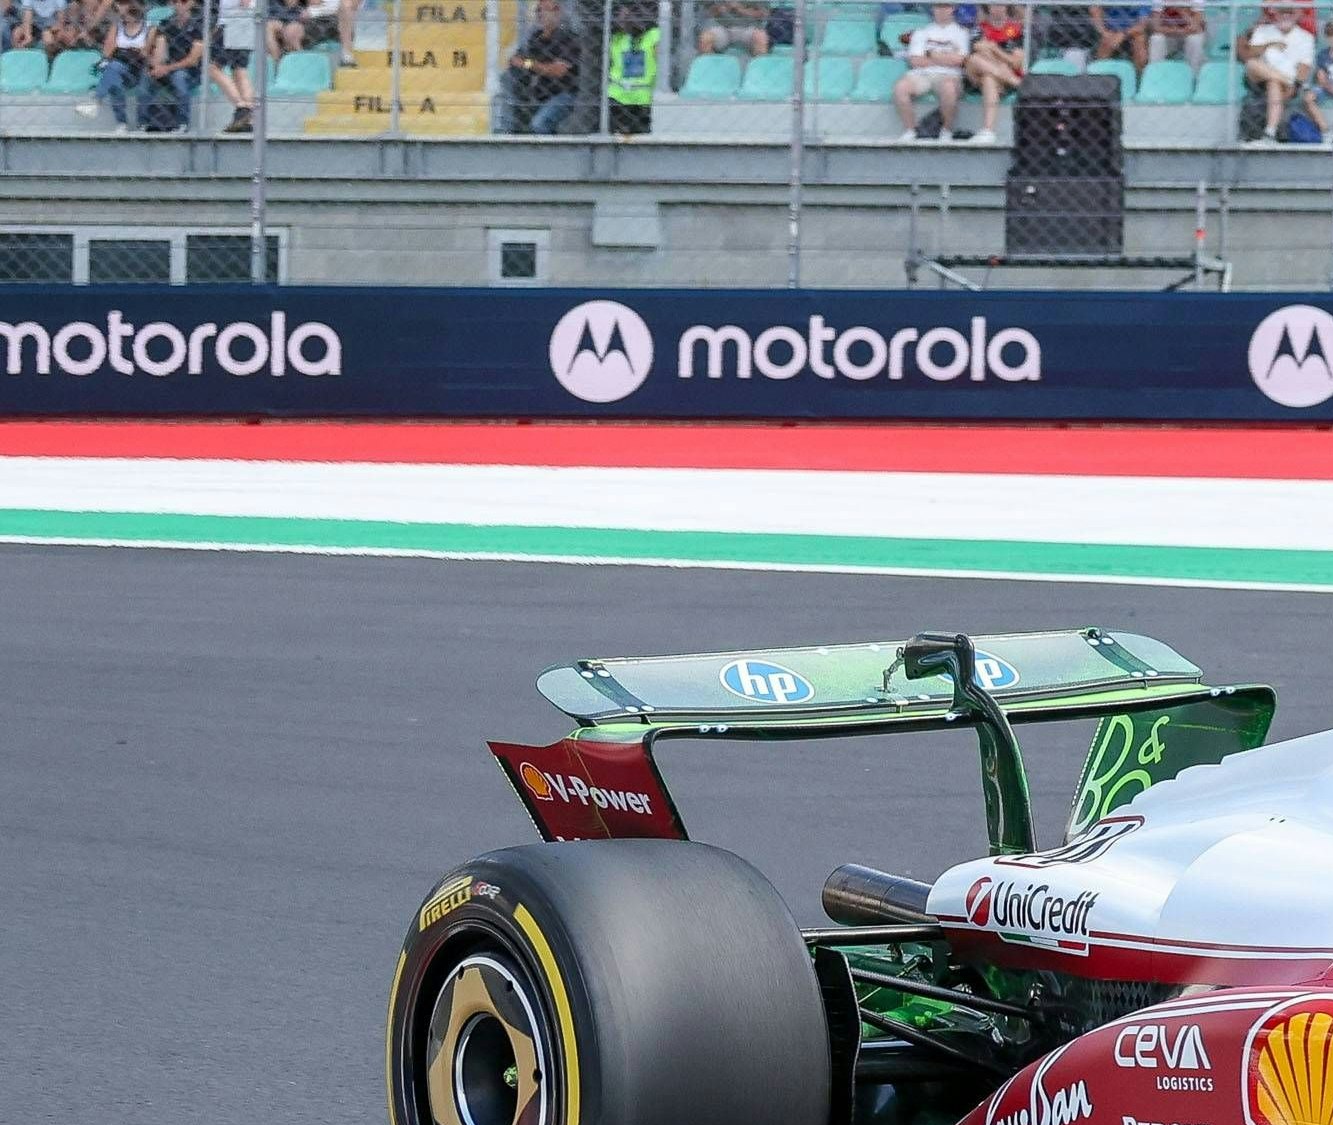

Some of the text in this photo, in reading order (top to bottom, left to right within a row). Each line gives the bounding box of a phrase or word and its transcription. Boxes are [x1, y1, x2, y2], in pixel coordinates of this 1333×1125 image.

[420, 97, 435, 114] A
[0, 311, 342, 376] motorola
[677, 316, 1042, 380] motorola
[735, 659, 799, 702] hp
[543, 772, 653, 815] V-Power
[418, 875, 474, 933] PIRELLI
[993, 880, 1100, 935] UniCredit
[1156, 1076, 1214, 1092] LOGISTICS
